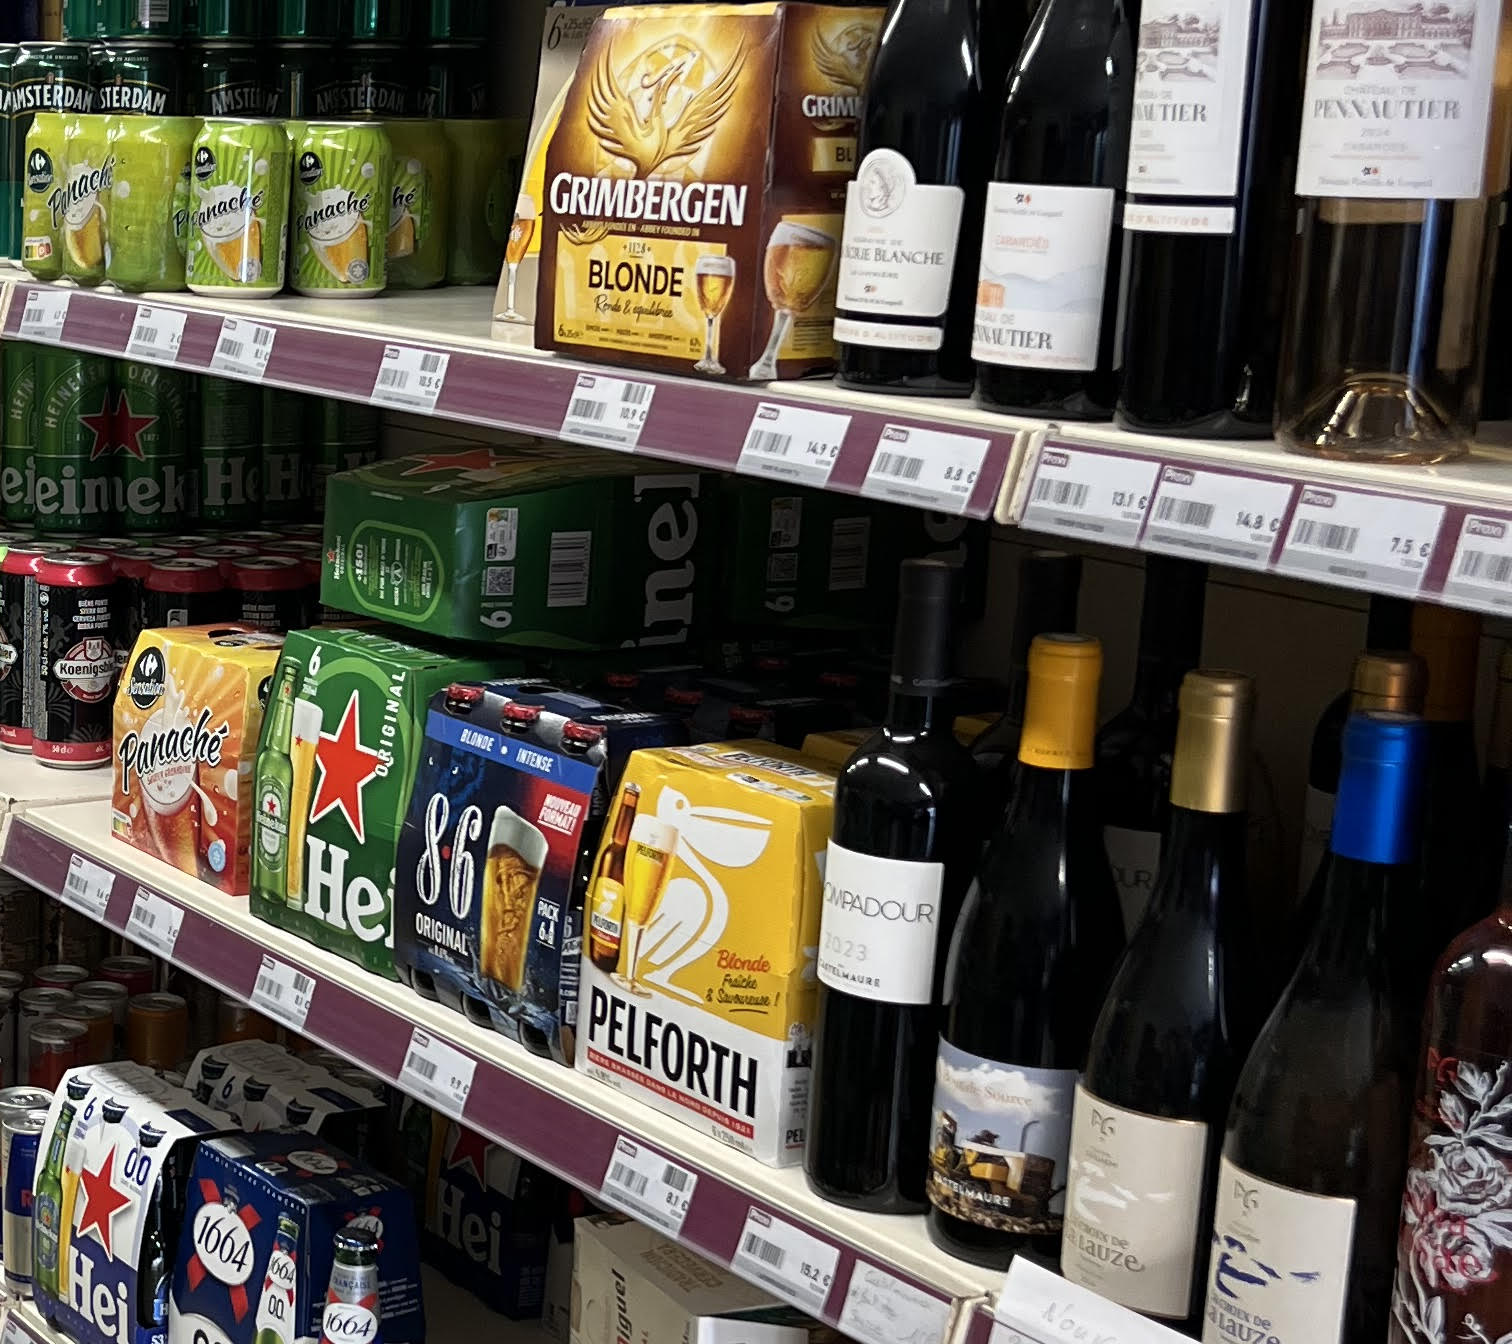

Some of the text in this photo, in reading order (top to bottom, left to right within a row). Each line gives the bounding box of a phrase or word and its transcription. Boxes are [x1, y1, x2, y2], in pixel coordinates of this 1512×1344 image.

[1314, 98, 1463, 122] PENNAUTIER
[549, 171, 748, 227] GRIMBERGEN
[875, 246, 946, 267] BLANCHE
[589, 259, 684, 298] BLONDE
[594, 293, 622, 314] Ronde
[1391, 536, 1413, 556] 7.5
[308, 645, 321, 676] 6
[374, 669, 407, 778] ORIGINAL
[119, 705, 230, 797] Panaché
[460, 728, 553, 774] BLONDE INTENSE
[538, 806, 576, 835] FORMAT!
[543, 792, 583, 822] NOUVEAU
[538, 898, 560, 923] PACK
[415, 911, 471, 957] ORIGINAL
[825, 932, 869, 963] 2023
[717, 949, 771, 973] Blonde
[706, 991, 715, 1004] &
[717, 989, 771, 1008] Savoureuse
[588, 984, 759, 1119] PELFORTH
[83, 1094, 96, 1122] 6
[123, 1147, 152, 1186] 0.0
[196, 1214, 251, 1275] 1664
[269, 1255, 297, 1284] 1664
[325, 1311, 376, 1338] 1664
